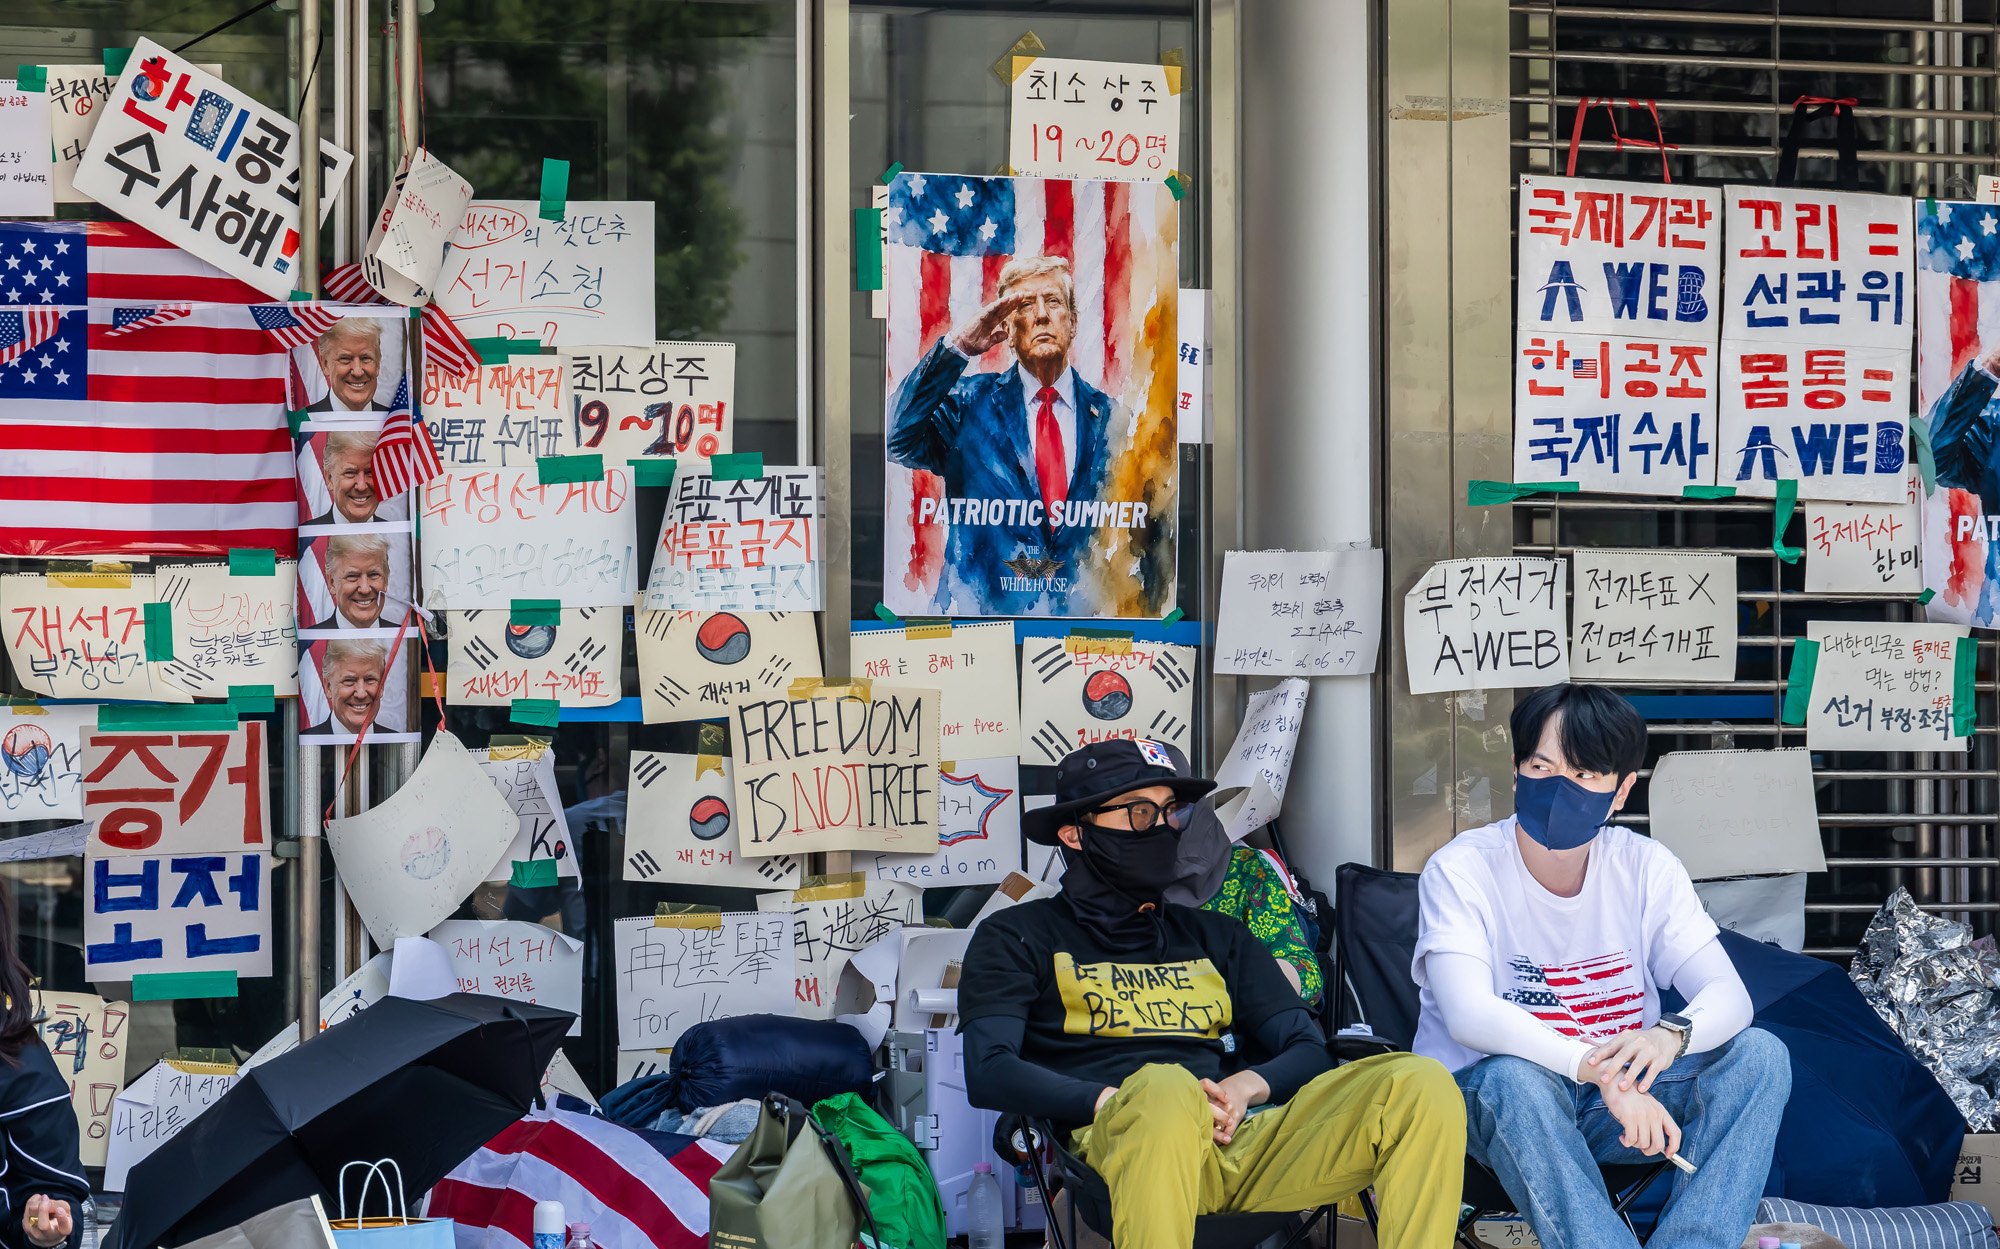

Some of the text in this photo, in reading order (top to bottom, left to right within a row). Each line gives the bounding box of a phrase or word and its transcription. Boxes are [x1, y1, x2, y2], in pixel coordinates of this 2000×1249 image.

[1738, 200, 1839, 262] 꼬리
[1602, 262, 1710, 323] WEB
[1740, 349, 1846, 410] 몸통
[919, 497, 1149, 529] PATRIOTIC SUMMER
[1027, 545, 1040, 555] THE
[1000, 576, 1067, 592] WHITE HOUSE
[1419, 562, 1558, 635] 부정선거
[1433, 629, 1561, 676] A-WEB
[1823, 632, 1952, 664] 대한민국을 통째로
[738, 695, 923, 764] FREEDOM
[942, 721, 964, 736] not
[1823, 695, 1873, 732] 선거
[83, 722, 265, 850] 증거
[744, 763, 931, 842] IS NOT FREE
[675, 848, 733, 865] 재선거
[875, 854, 996, 881] Freedom
[86, 854, 261, 965] 보전
[1111, 964, 1195, 991] AWARE
[1117, 990, 1141, 1002] or
[633, 998, 680, 1038] for
[1083, 991, 1130, 1035] BE
